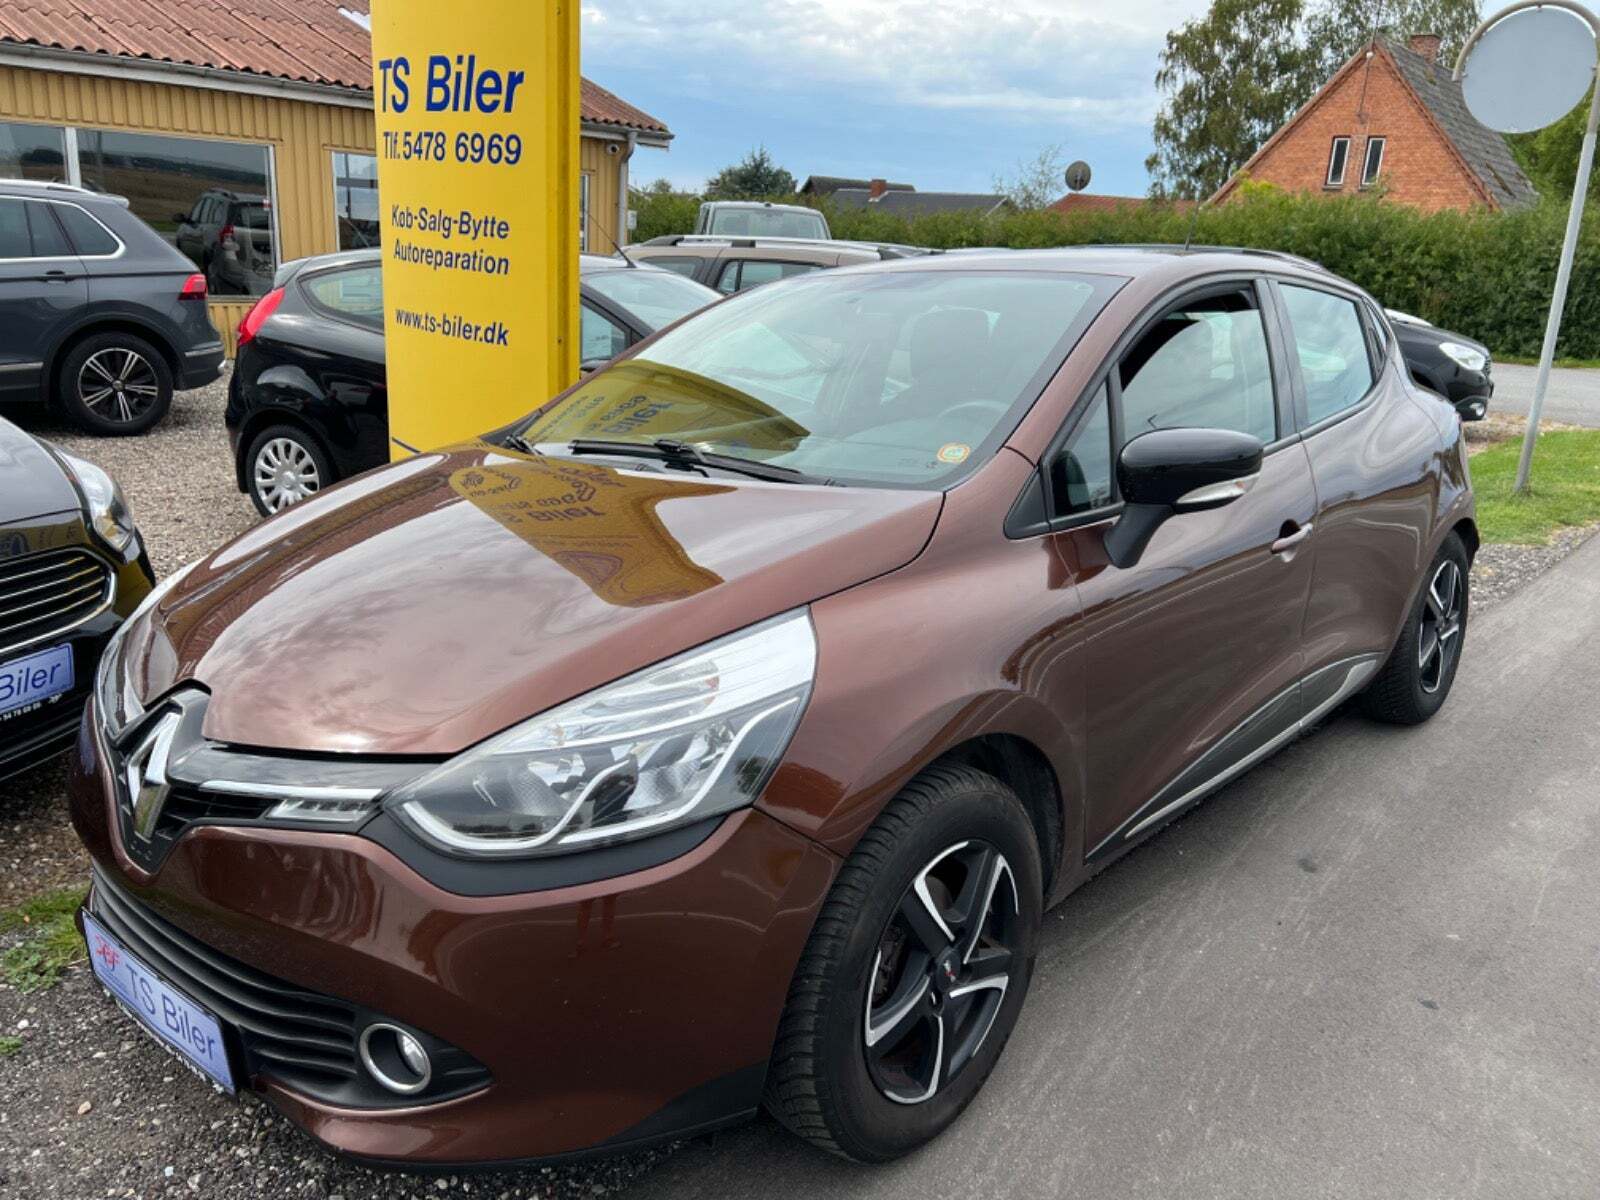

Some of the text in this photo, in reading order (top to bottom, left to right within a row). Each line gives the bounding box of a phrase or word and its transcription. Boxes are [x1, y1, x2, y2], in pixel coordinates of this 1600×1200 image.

[379, 54, 525, 113] TS Biler
[455, 131, 522, 165] 6969
[393, 238, 510, 276] Autoreparation
[395, 308, 510, 347] www.ts-biler.dk
[126, 963, 156, 1016] TS
[161, 993, 216, 1061] Biler
